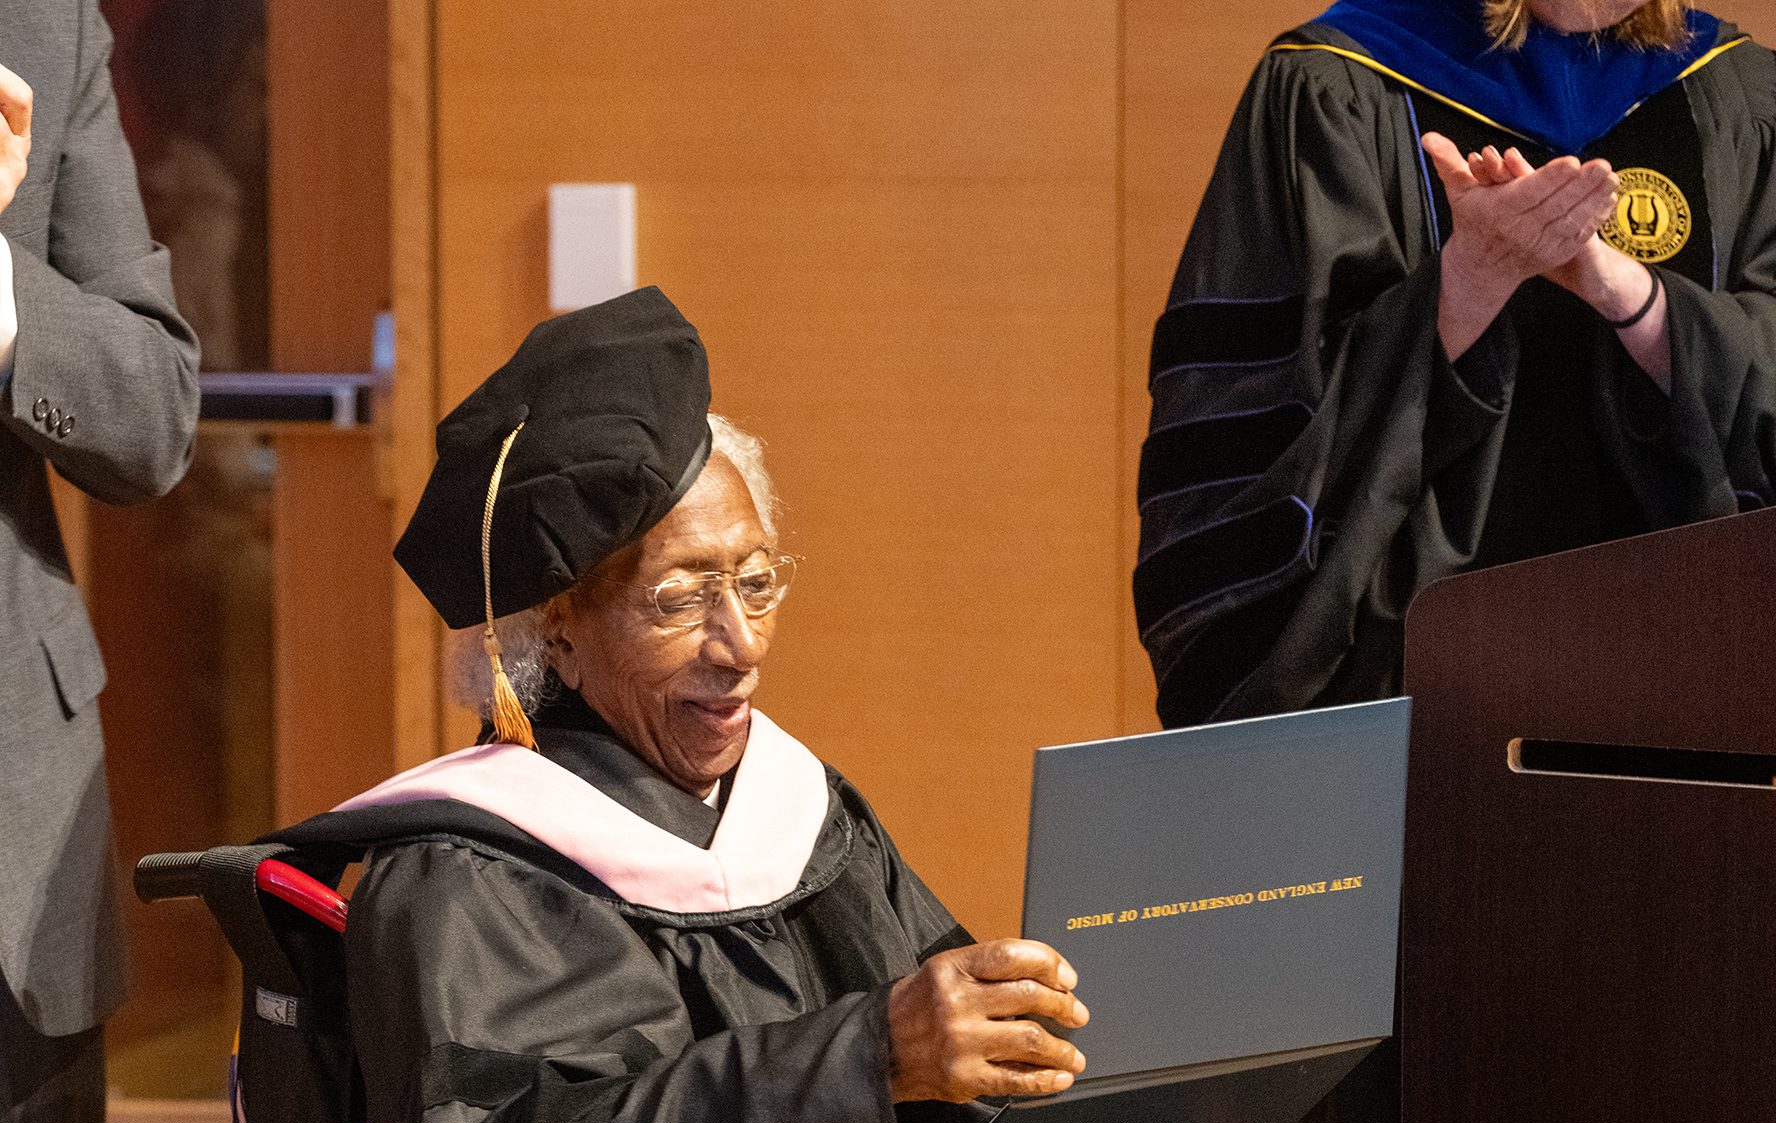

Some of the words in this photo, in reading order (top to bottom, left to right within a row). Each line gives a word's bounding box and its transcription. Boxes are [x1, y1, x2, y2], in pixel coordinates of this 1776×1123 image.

[1619, 172, 1687, 216] ONSERVATORY
[1257, 881, 1327, 902] ENGLAND
[1329, 876, 1364, 892] NEW
[1140, 892, 1255, 919] CONSERVATORY
[1066, 912, 1115, 930] MUSIC
[1117, 909, 1138, 923] OF
